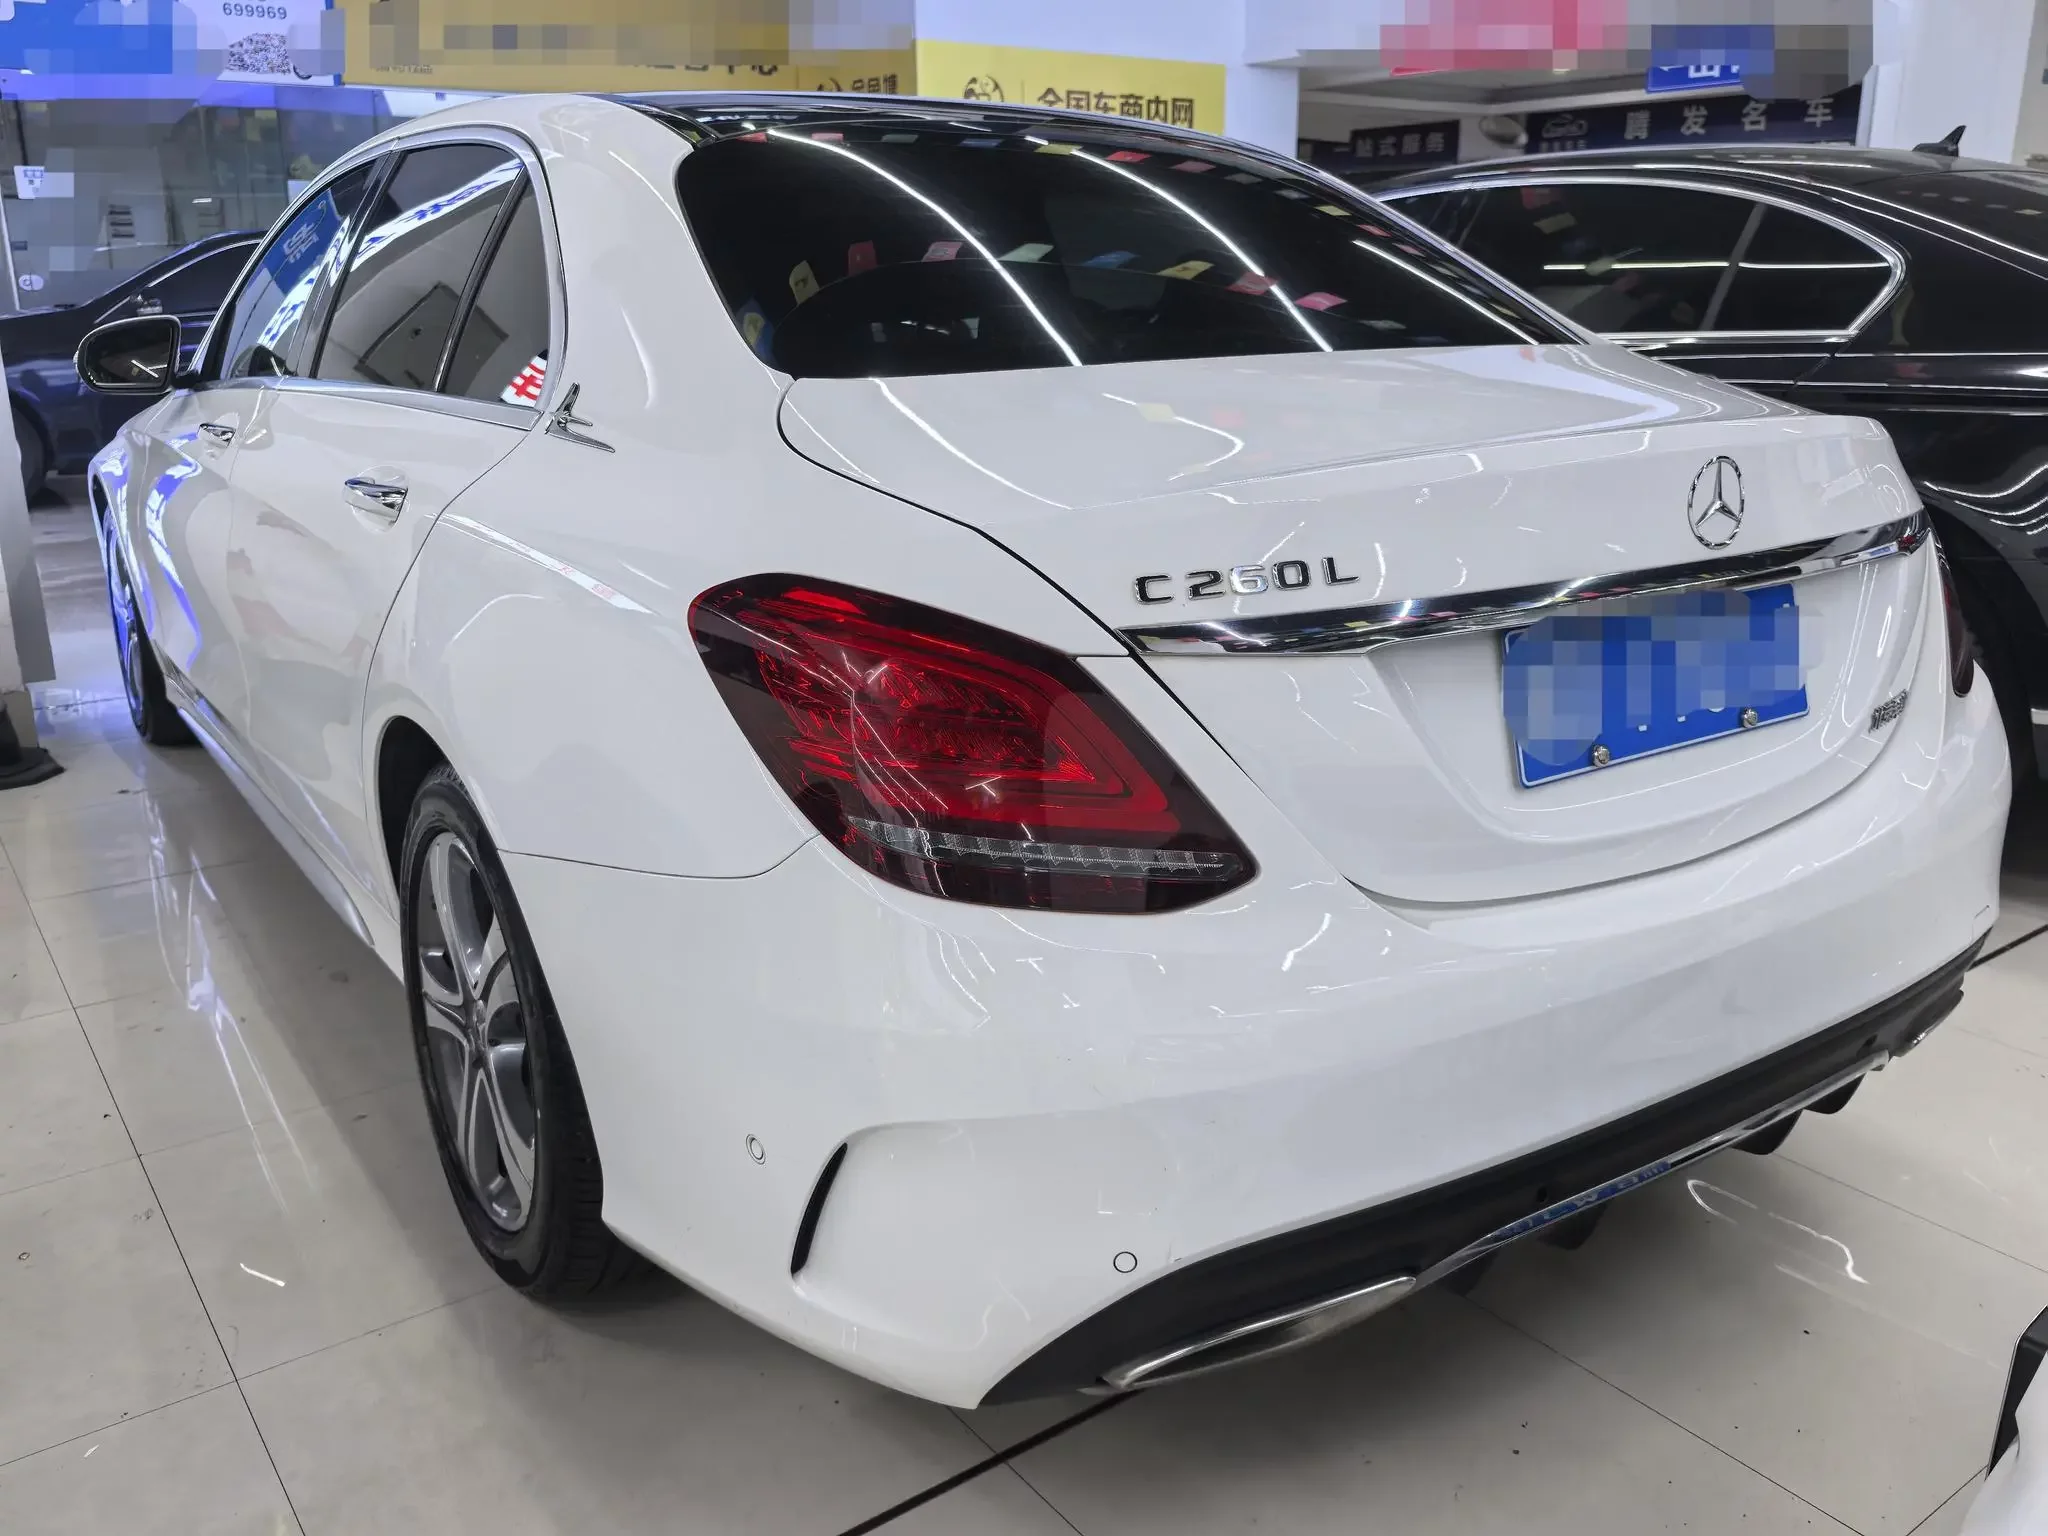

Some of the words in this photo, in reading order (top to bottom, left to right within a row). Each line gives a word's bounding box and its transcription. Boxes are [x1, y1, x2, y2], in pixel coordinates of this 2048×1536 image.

[223, 2, 287, 19] 699969
[1134, 574, 1174, 606] C
[1184, 559, 1312, 601] 260
[1321, 556, 1360, 586] L
